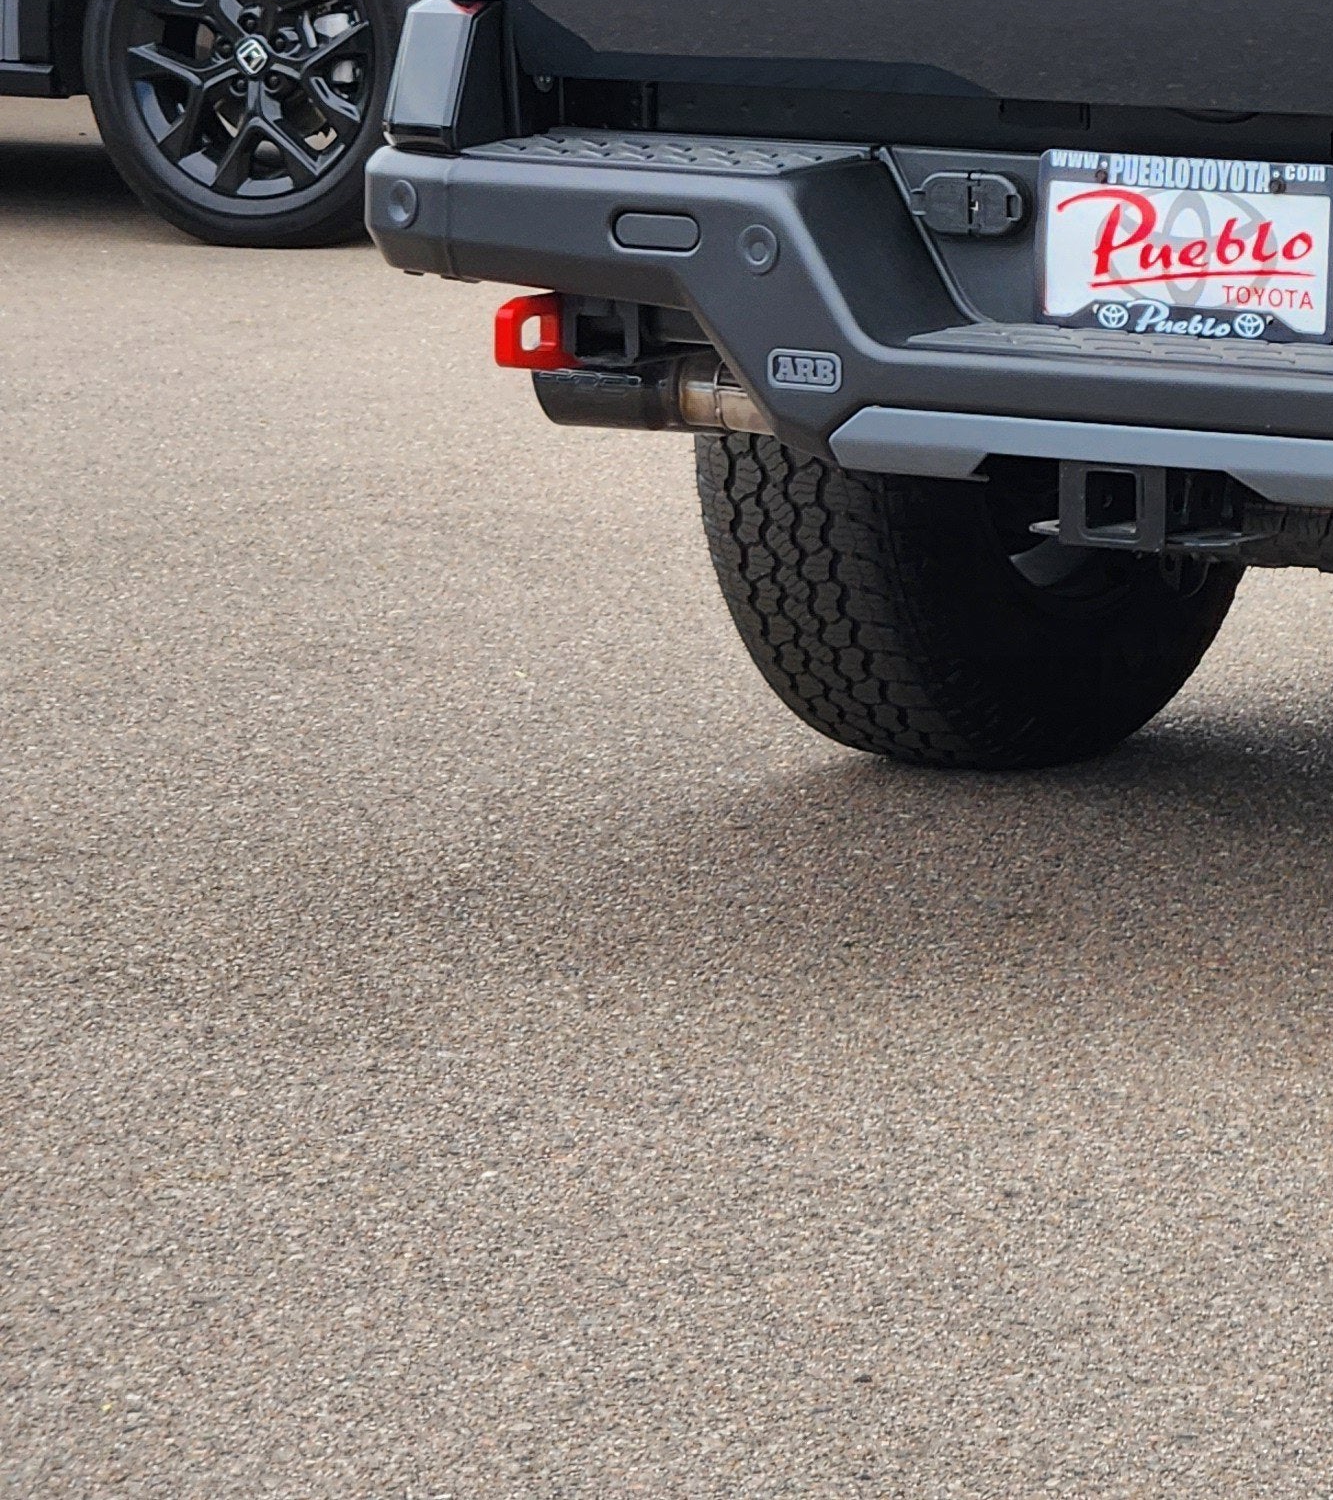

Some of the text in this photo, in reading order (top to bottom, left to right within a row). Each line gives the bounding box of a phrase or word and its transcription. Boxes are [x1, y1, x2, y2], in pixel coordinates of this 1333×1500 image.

[1056, 189, 1313, 276] Pueblo
[1222, 285, 1314, 310] TOYOTA
[1126, 299, 1232, 337] Pueblo
[775, 355, 837, 386] ARB
